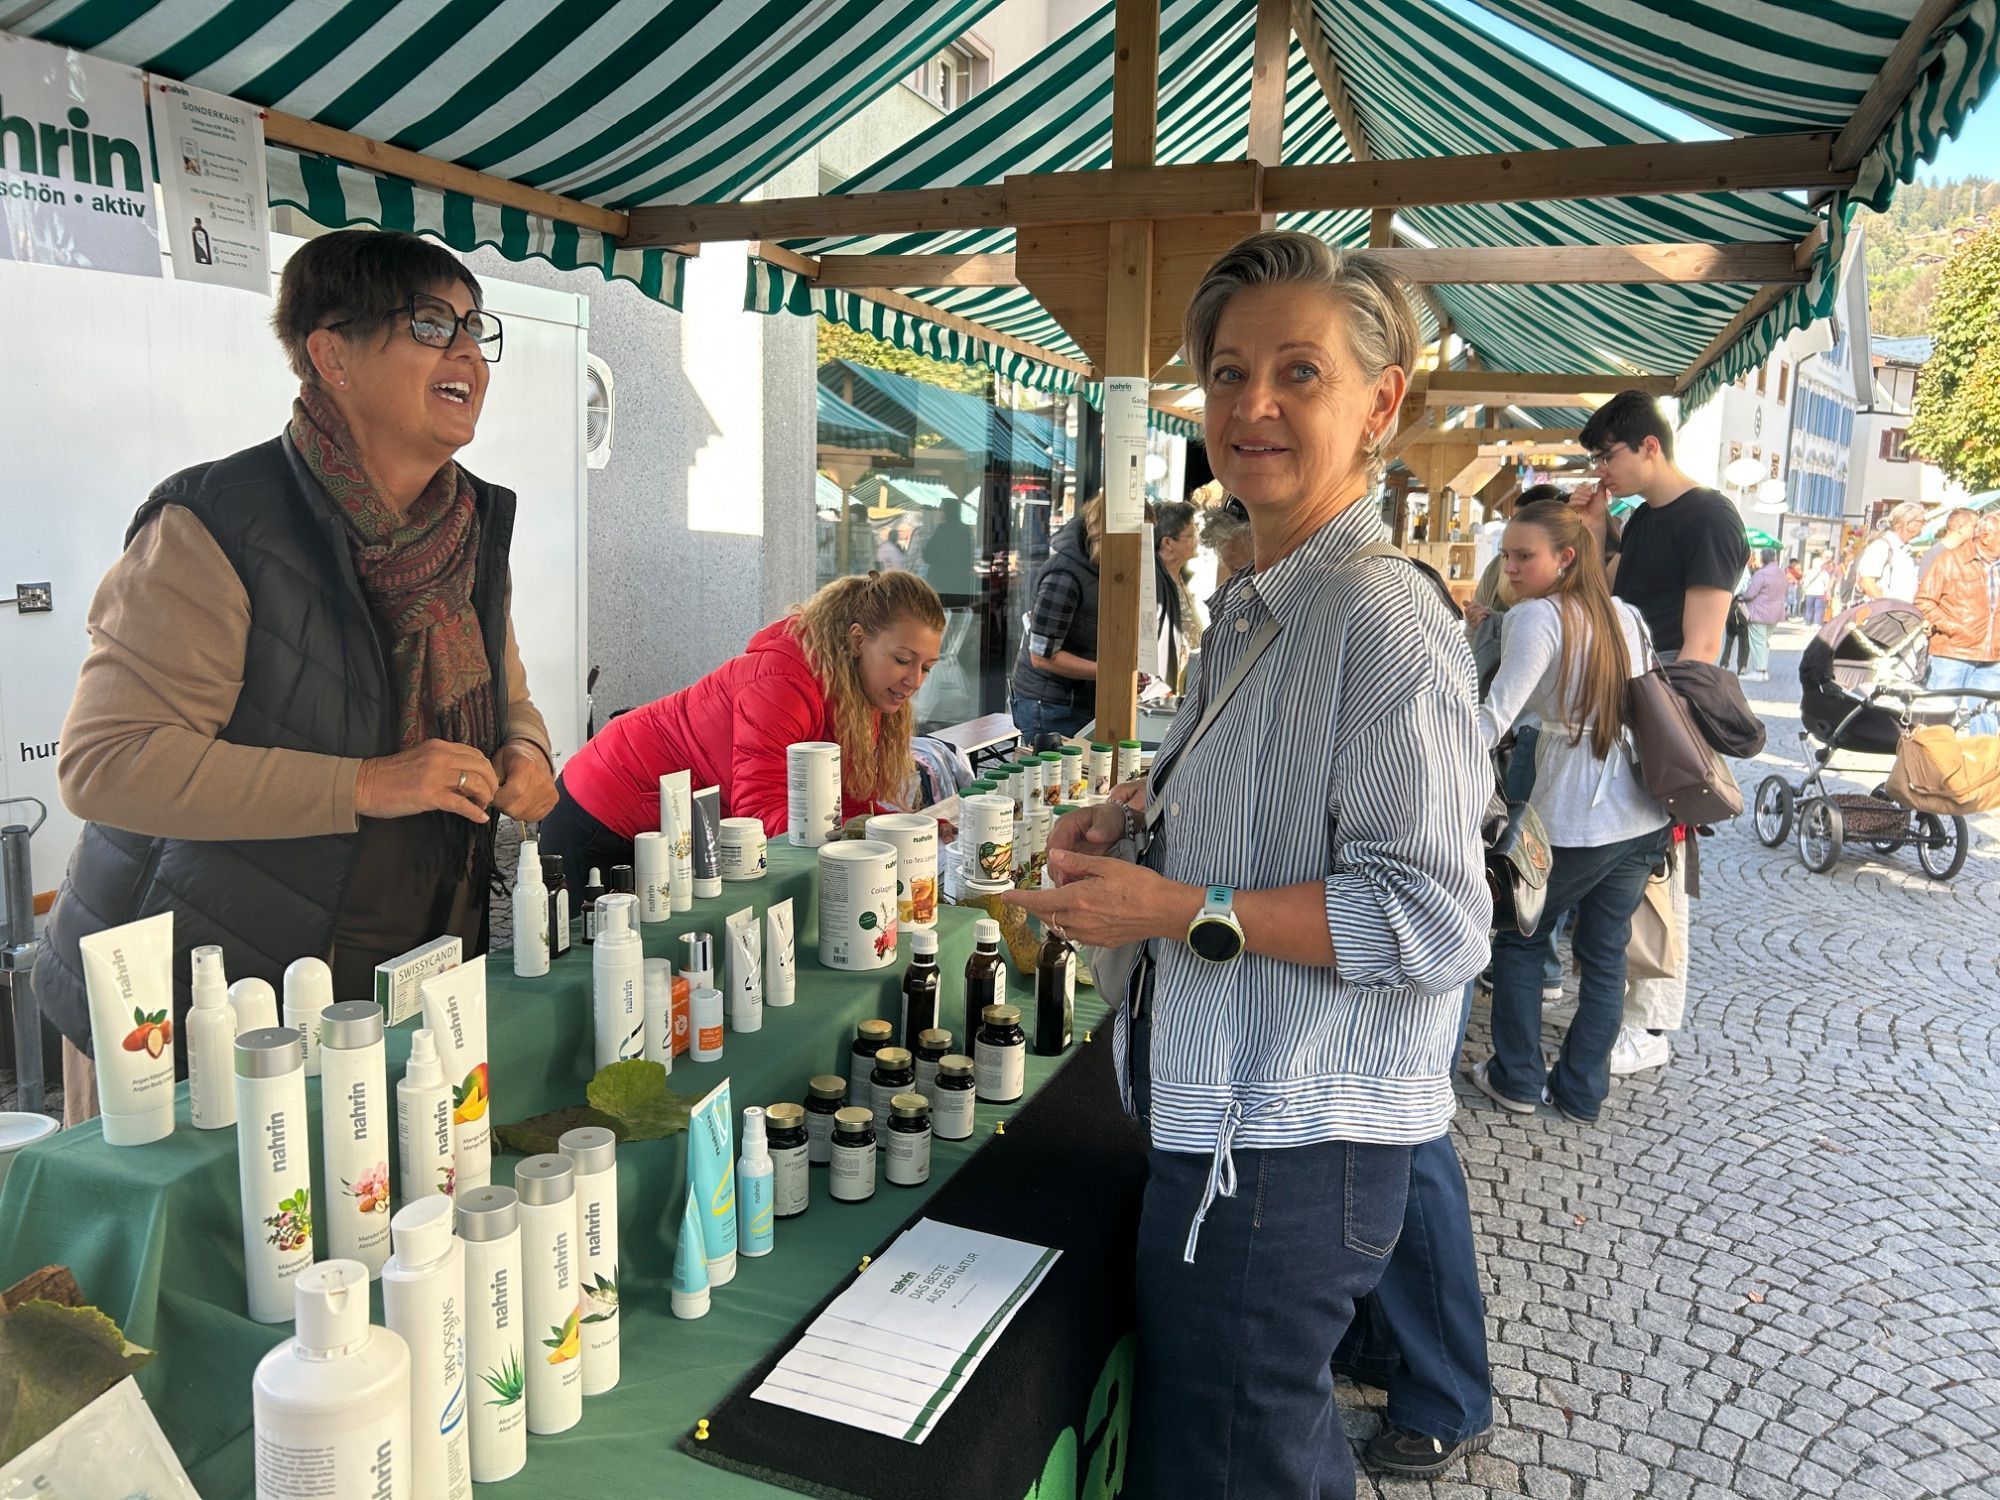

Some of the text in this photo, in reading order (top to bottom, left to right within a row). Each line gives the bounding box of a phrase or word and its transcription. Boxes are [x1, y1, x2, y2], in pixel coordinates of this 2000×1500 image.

[92, 194, 146, 218] aktiv
[1109, 382, 1132, 390] nahrin
[913, 834, 934, 844] nahrin
[647, 884, 656, 913] nahrin
[112, 947, 132, 999] nahrin
[398, 943, 459, 982] SWISSYCANDY
[623, 979, 633, 1014] nahrin
[446, 995, 464, 1050] nahrin
[348, 1081, 368, 1141] nahrin
[433, 1099, 449, 1157] nahrin
[266, 1111, 287, 1173] nahrin
[584, 1201, 600, 1257] nahrin
[552, 1231, 568, 1290] nahrin
[889, 1271, 918, 1294] nahrin
[908, 1283, 930, 1300] DAS
[923, 1264, 950, 1285] BESTE
[926, 1288, 947, 1304] AUS
[939, 1274, 960, 1290] DER
[952, 1252, 981, 1275] NATUR
[490, 1268, 508, 1330] nahrin
[442, 1297, 458, 1386] SWISSCARE
[498, 1416, 511, 1425] Aloe
[498, 1424, 511, 1433] Aloe
